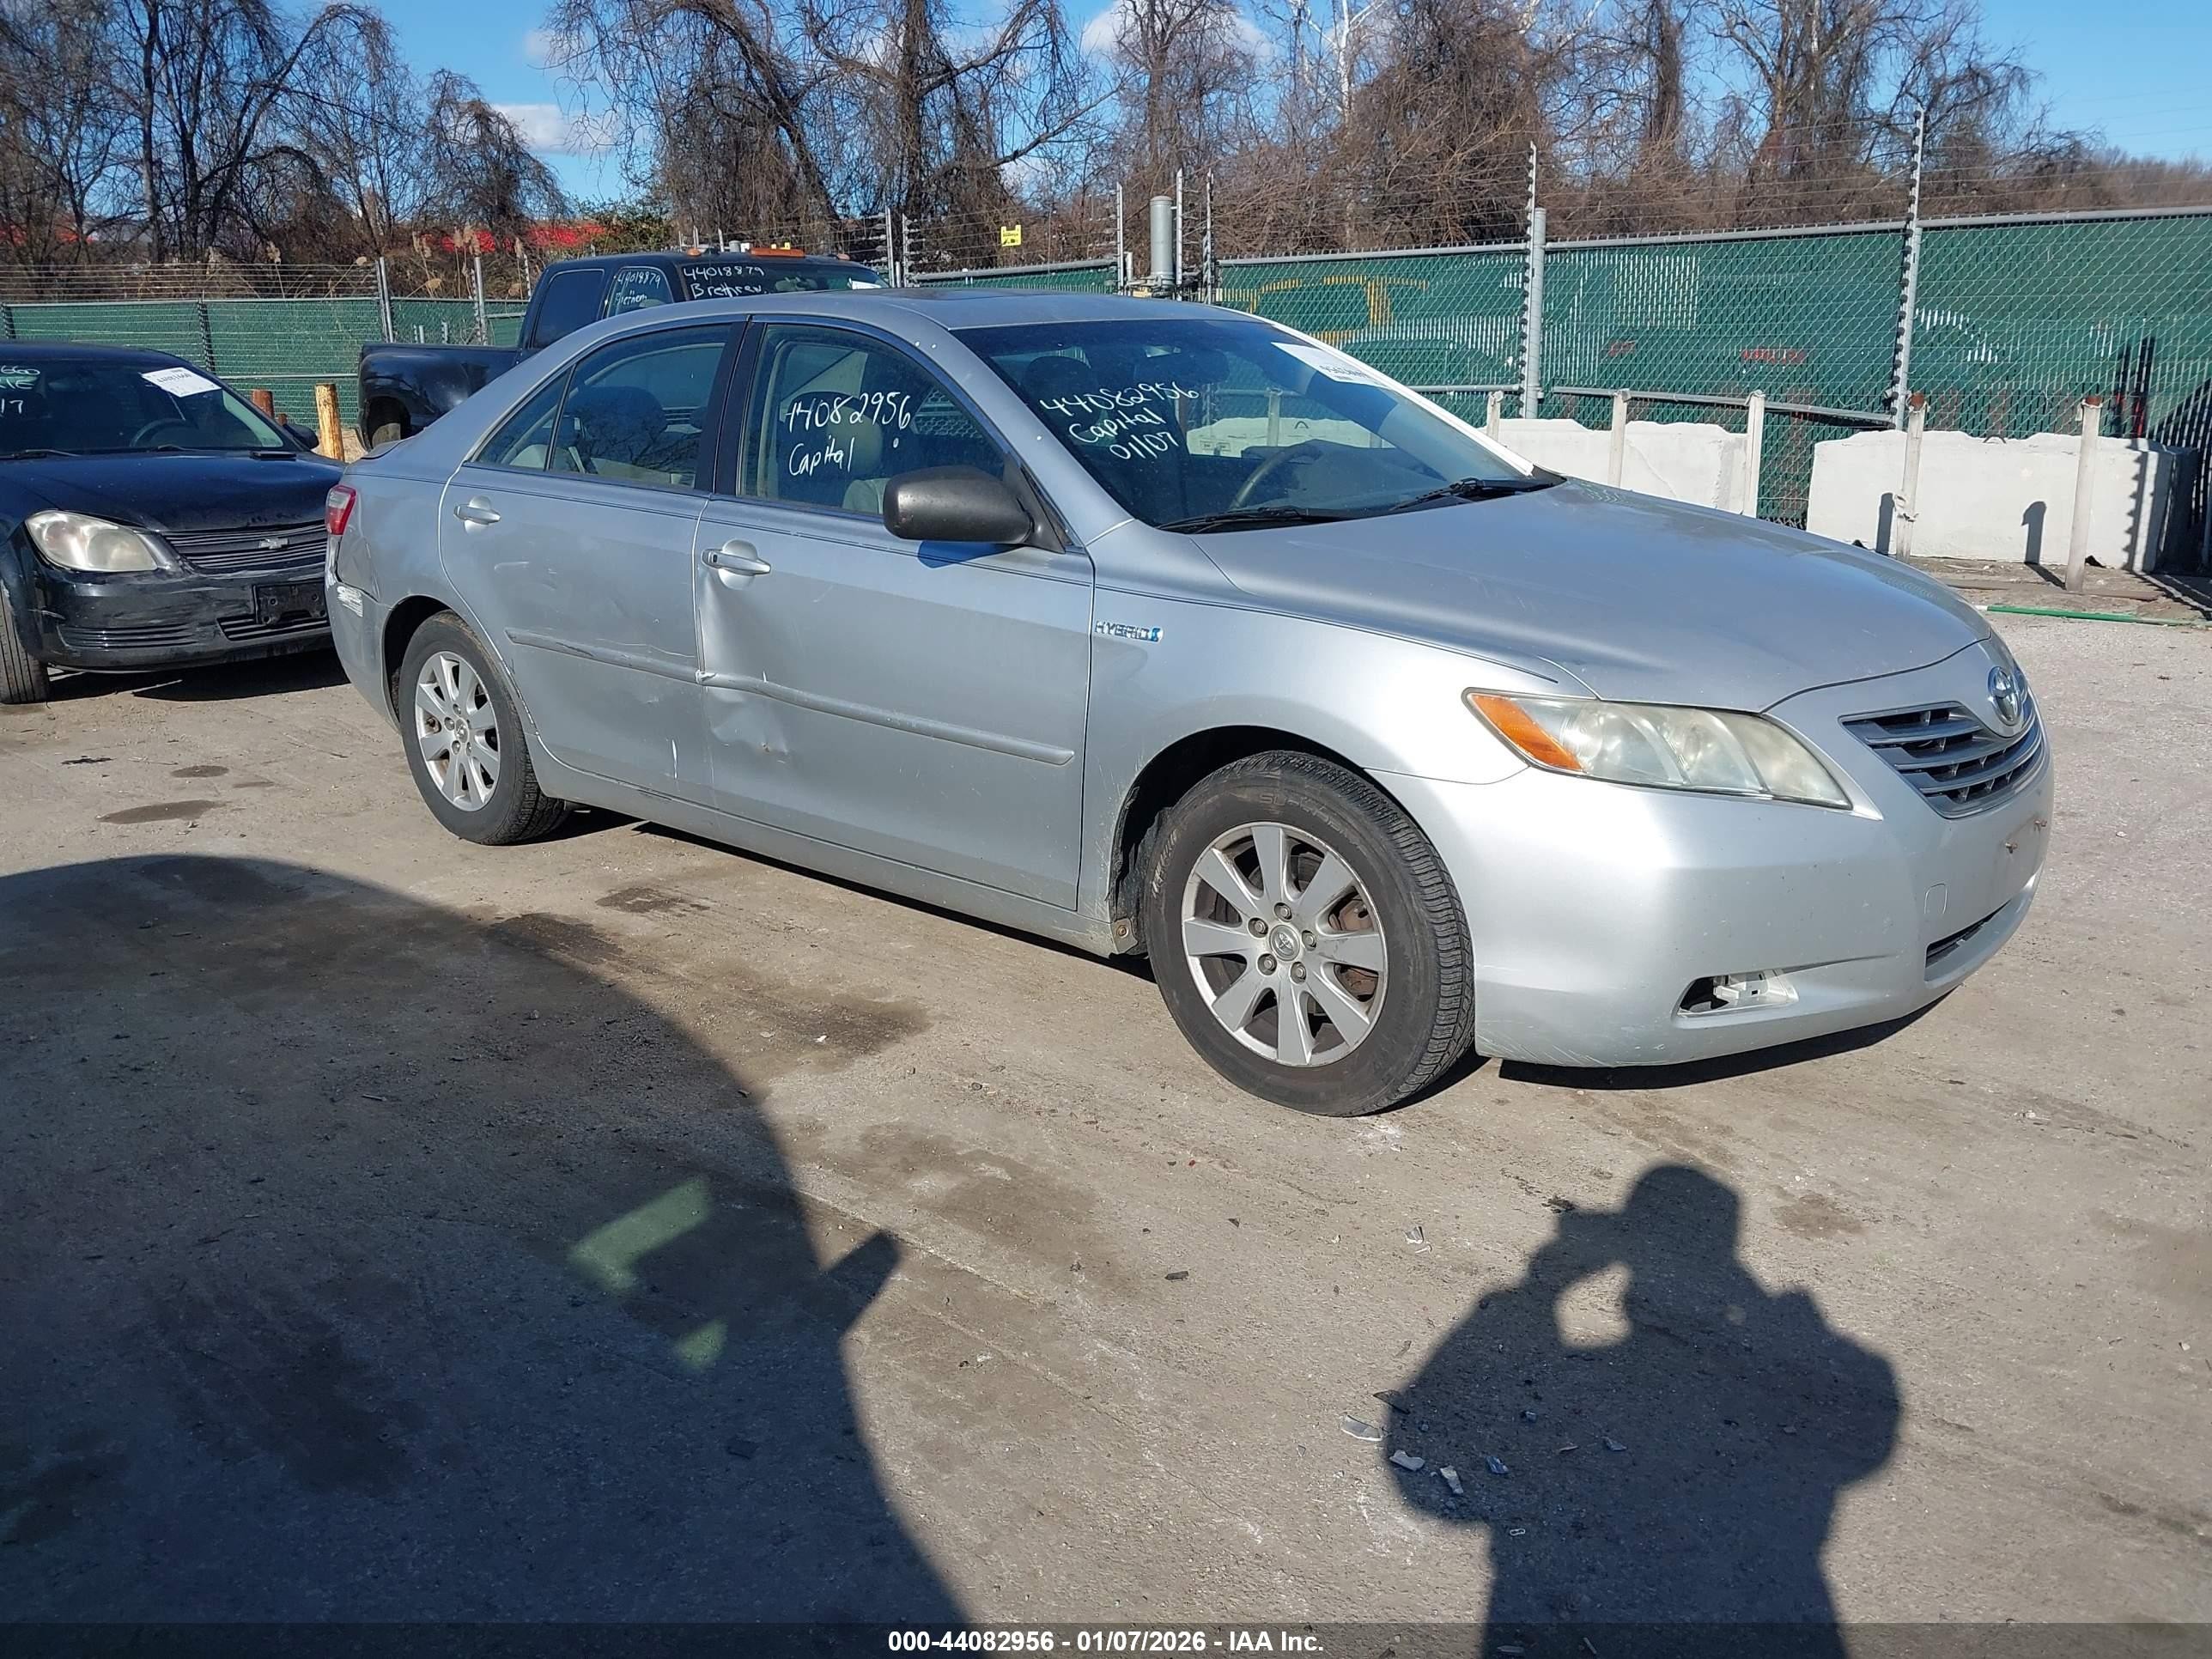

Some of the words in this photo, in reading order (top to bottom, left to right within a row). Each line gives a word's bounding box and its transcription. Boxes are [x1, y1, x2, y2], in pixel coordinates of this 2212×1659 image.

[684, 265, 765, 282] 44018879
[1040, 381, 1200, 416] 44082956
[1068, 407, 1166, 443] Capital
[788, 434, 855, 477] Capital
[1109, 431, 1179, 459] 01/07
[1095, 621, 1150, 641] HYBRID
